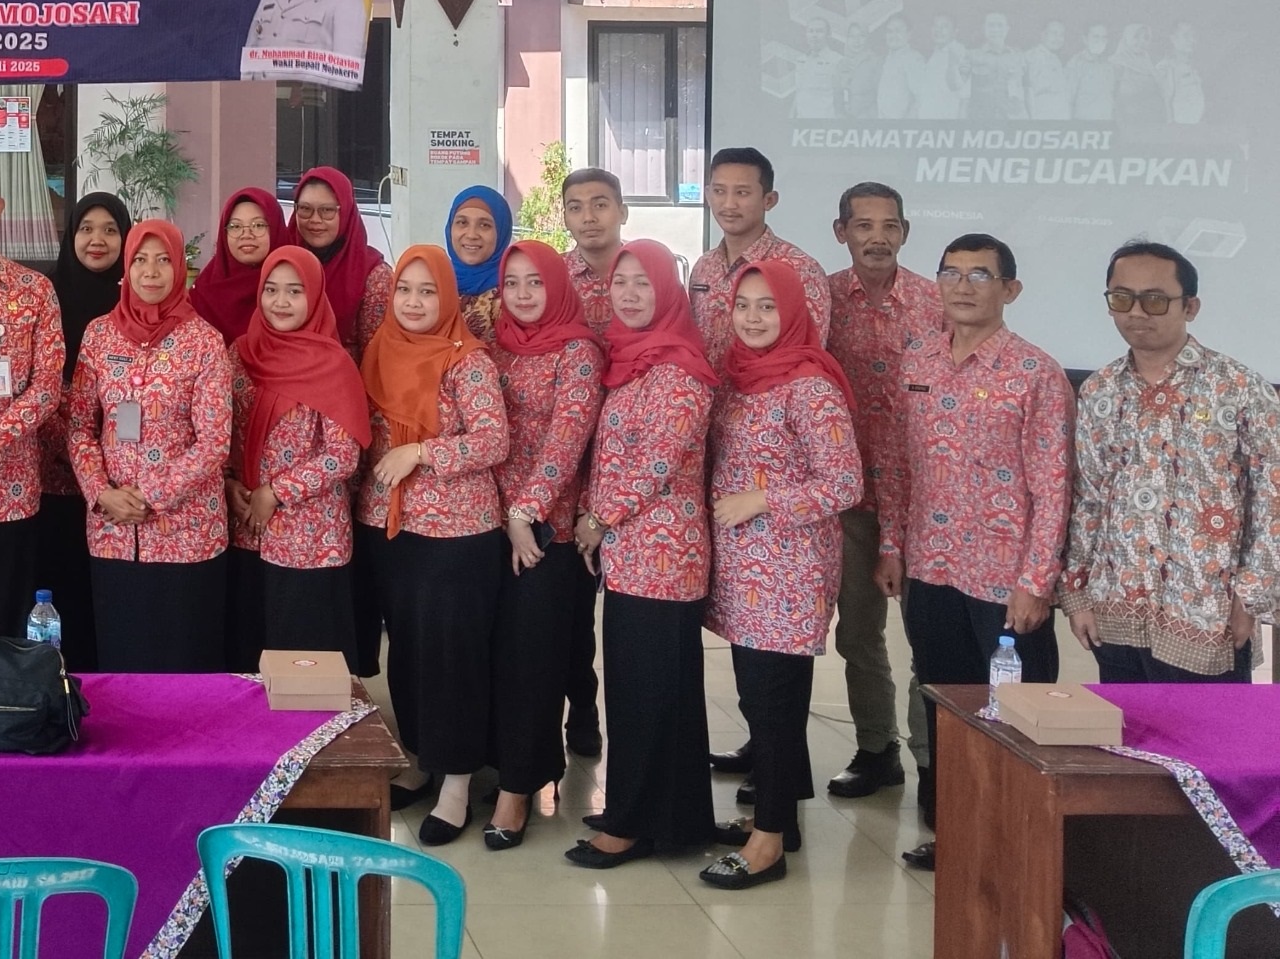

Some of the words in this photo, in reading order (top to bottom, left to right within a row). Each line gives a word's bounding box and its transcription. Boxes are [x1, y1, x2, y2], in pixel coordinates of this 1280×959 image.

[10, 60, 40, 73] 2025
[430, 130, 471, 139] TEMPAT
[792, 128, 955, 149] KECAMATAN
[961, 130, 1113, 151] MOJOSARI
[430, 139, 475, 147] SMOKING
[915, 157, 1233, 187] MENGUCAPKAN
[922, 208, 985, 221] INDONESIA
